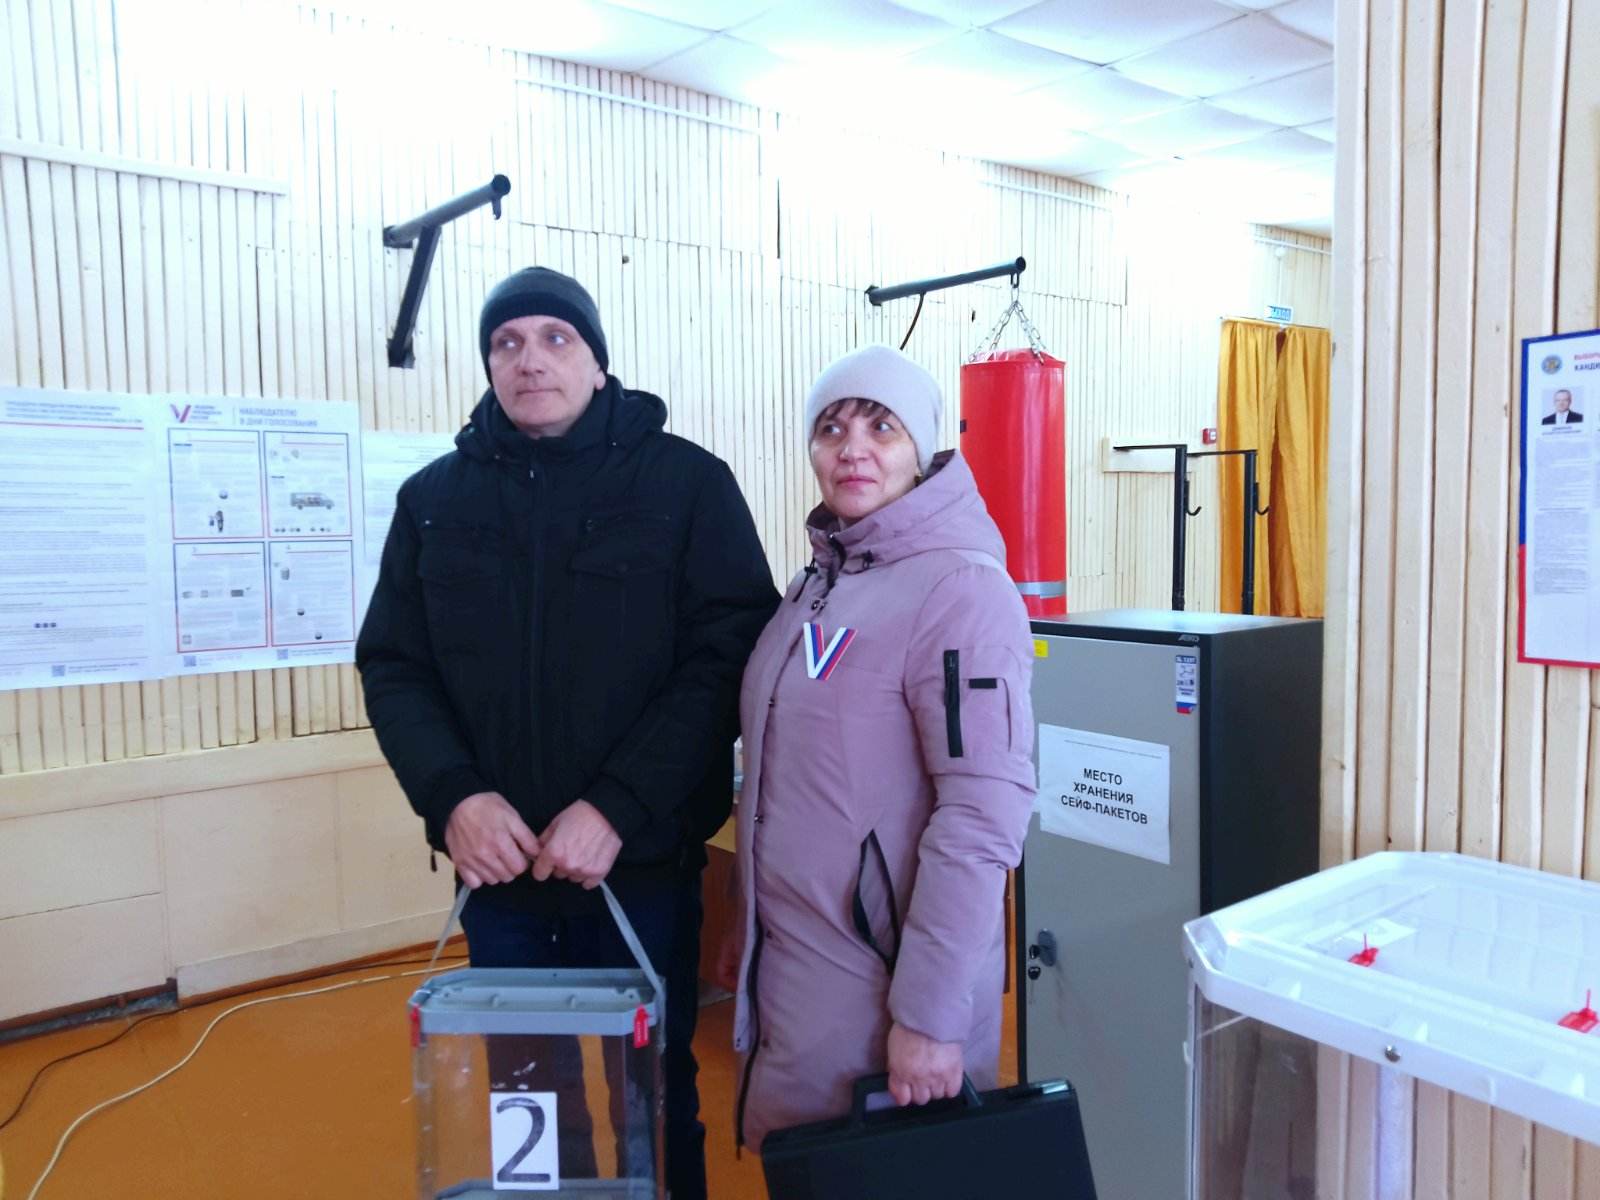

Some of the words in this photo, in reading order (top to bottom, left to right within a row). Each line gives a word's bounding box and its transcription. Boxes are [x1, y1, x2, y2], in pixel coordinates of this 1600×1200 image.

[1083, 768, 1123, 785] МЕСТО
[1073, 781, 1134, 804] ХРАНЕНИЯ
[1060, 794, 1148, 824] СЕЙФ-ПАКЕТОВ
[496, 1097, 551, 1183] 2
